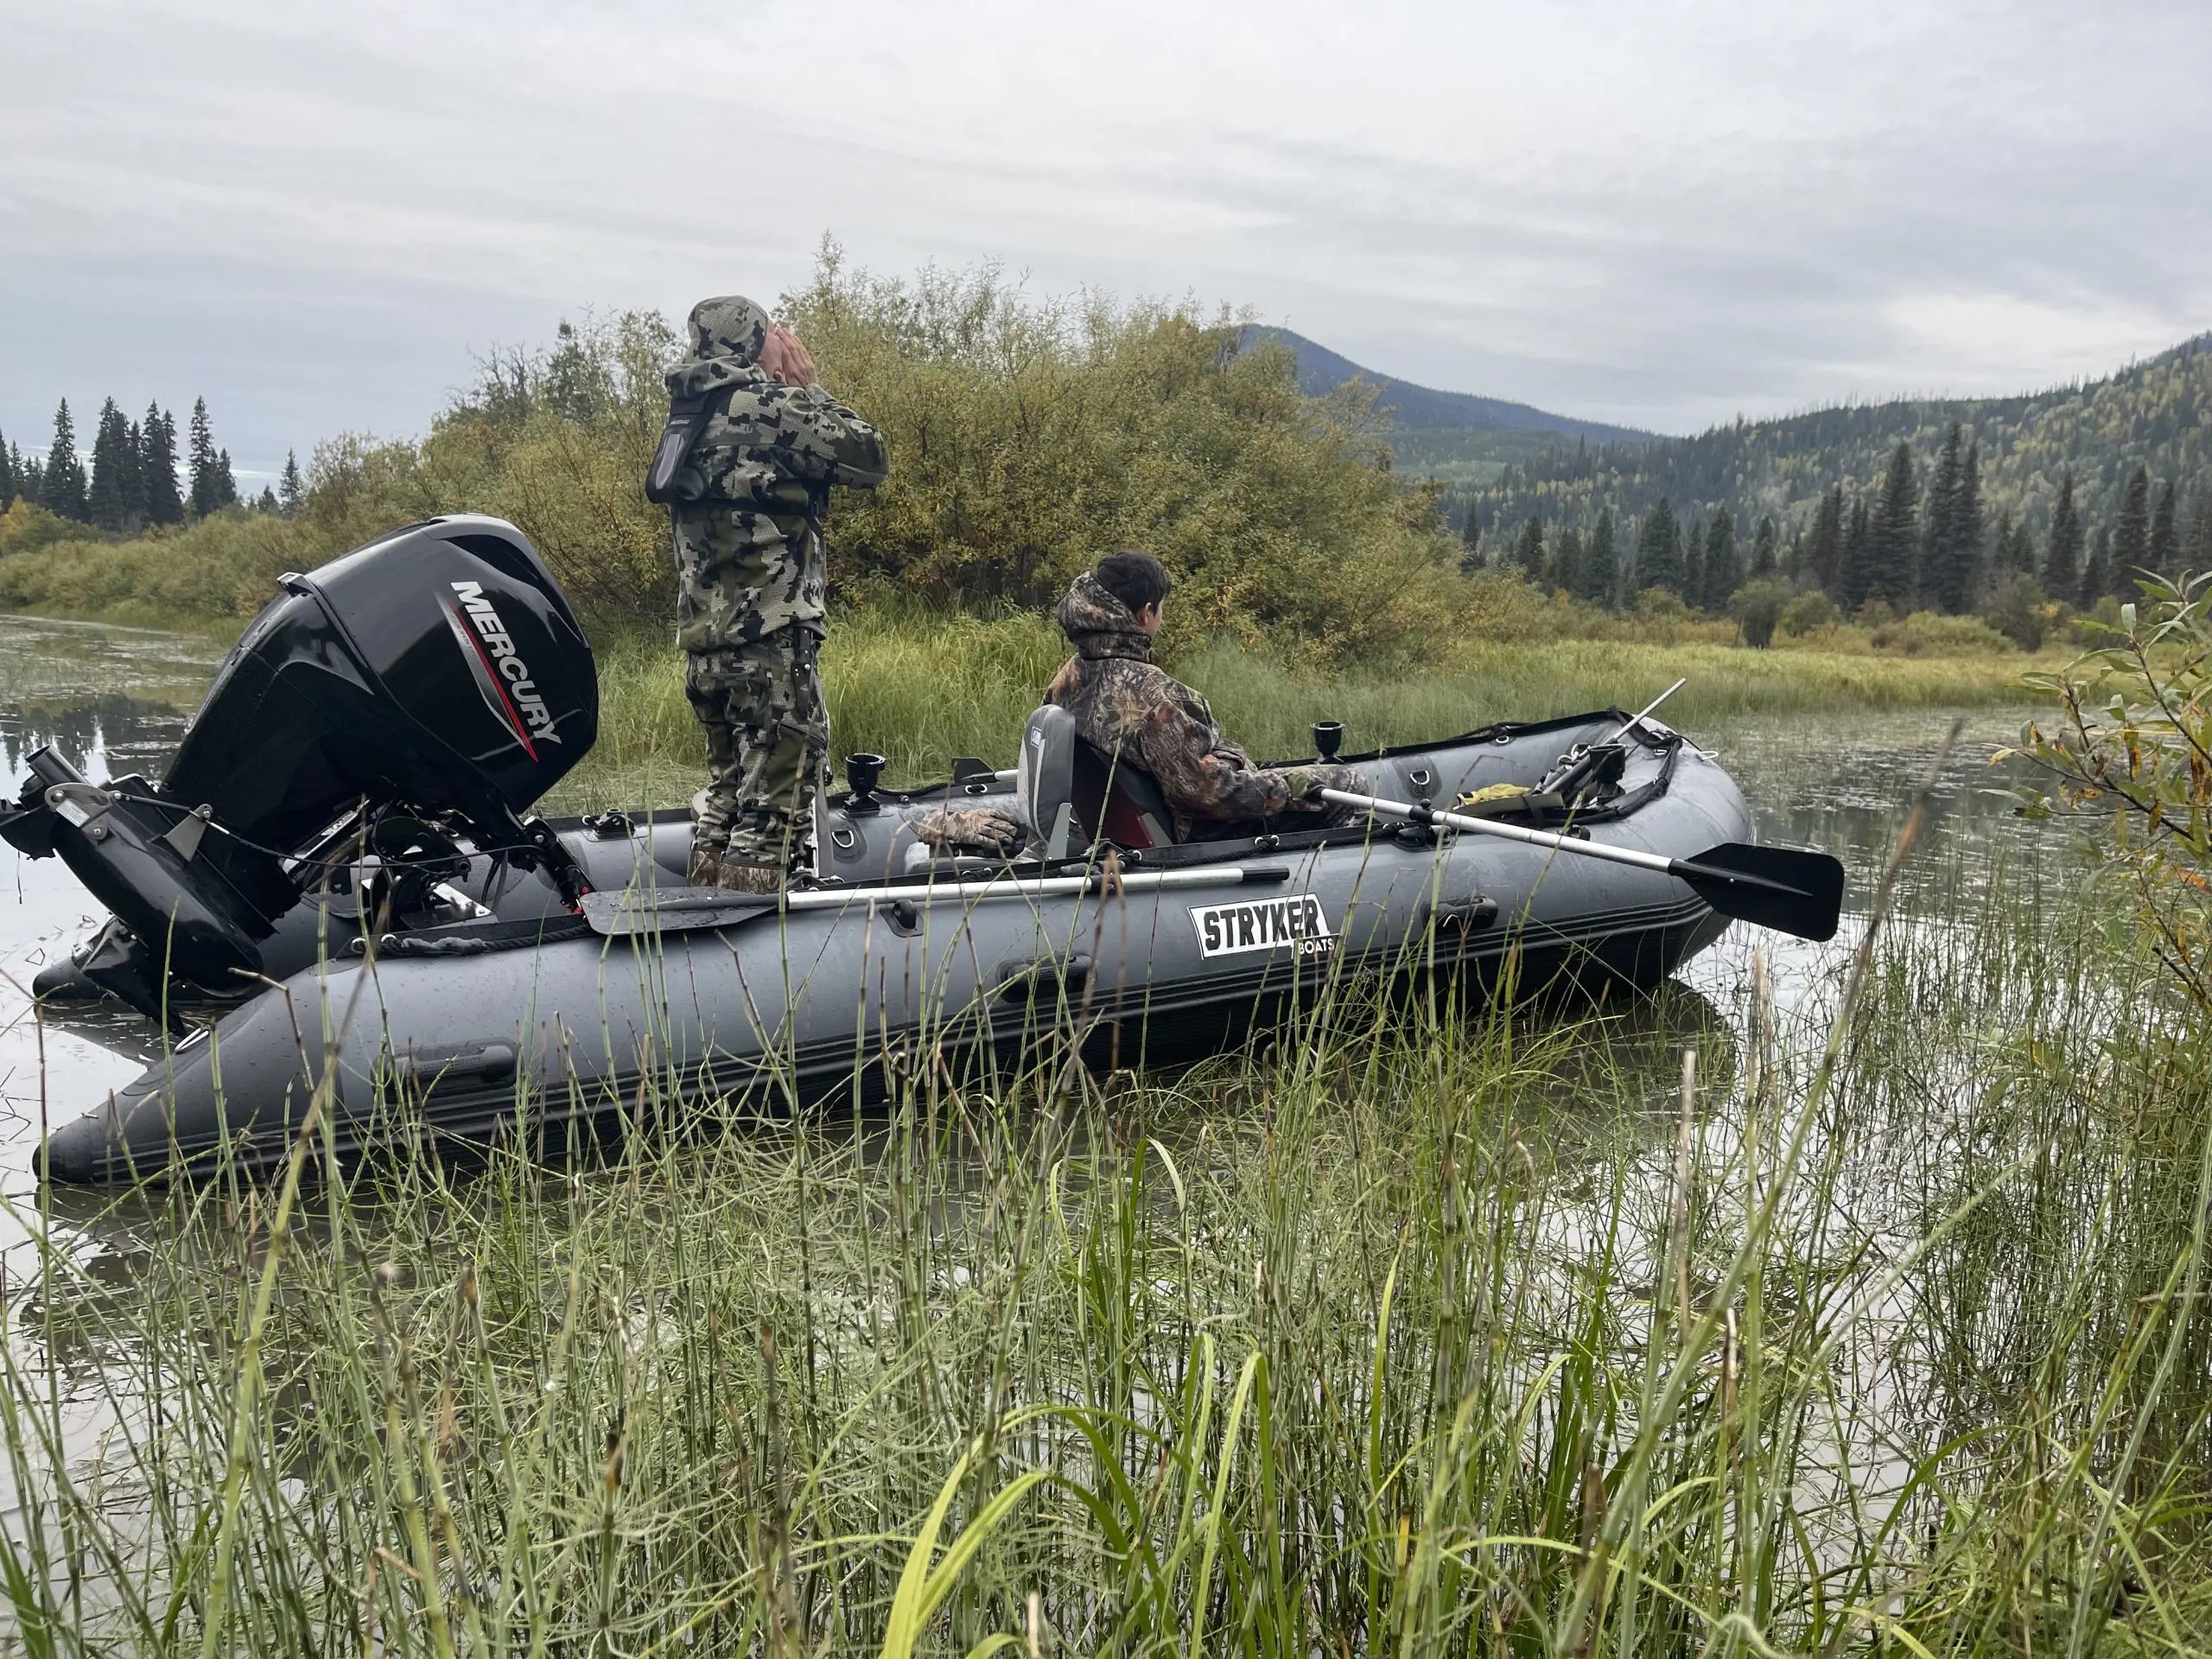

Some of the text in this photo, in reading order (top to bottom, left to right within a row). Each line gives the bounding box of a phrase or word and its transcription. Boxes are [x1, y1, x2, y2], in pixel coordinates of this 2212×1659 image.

[450, 581, 562, 744] MERCURY
[1204, 899, 1320, 950] STRYKER
[1298, 938, 1335, 955] BOATS
